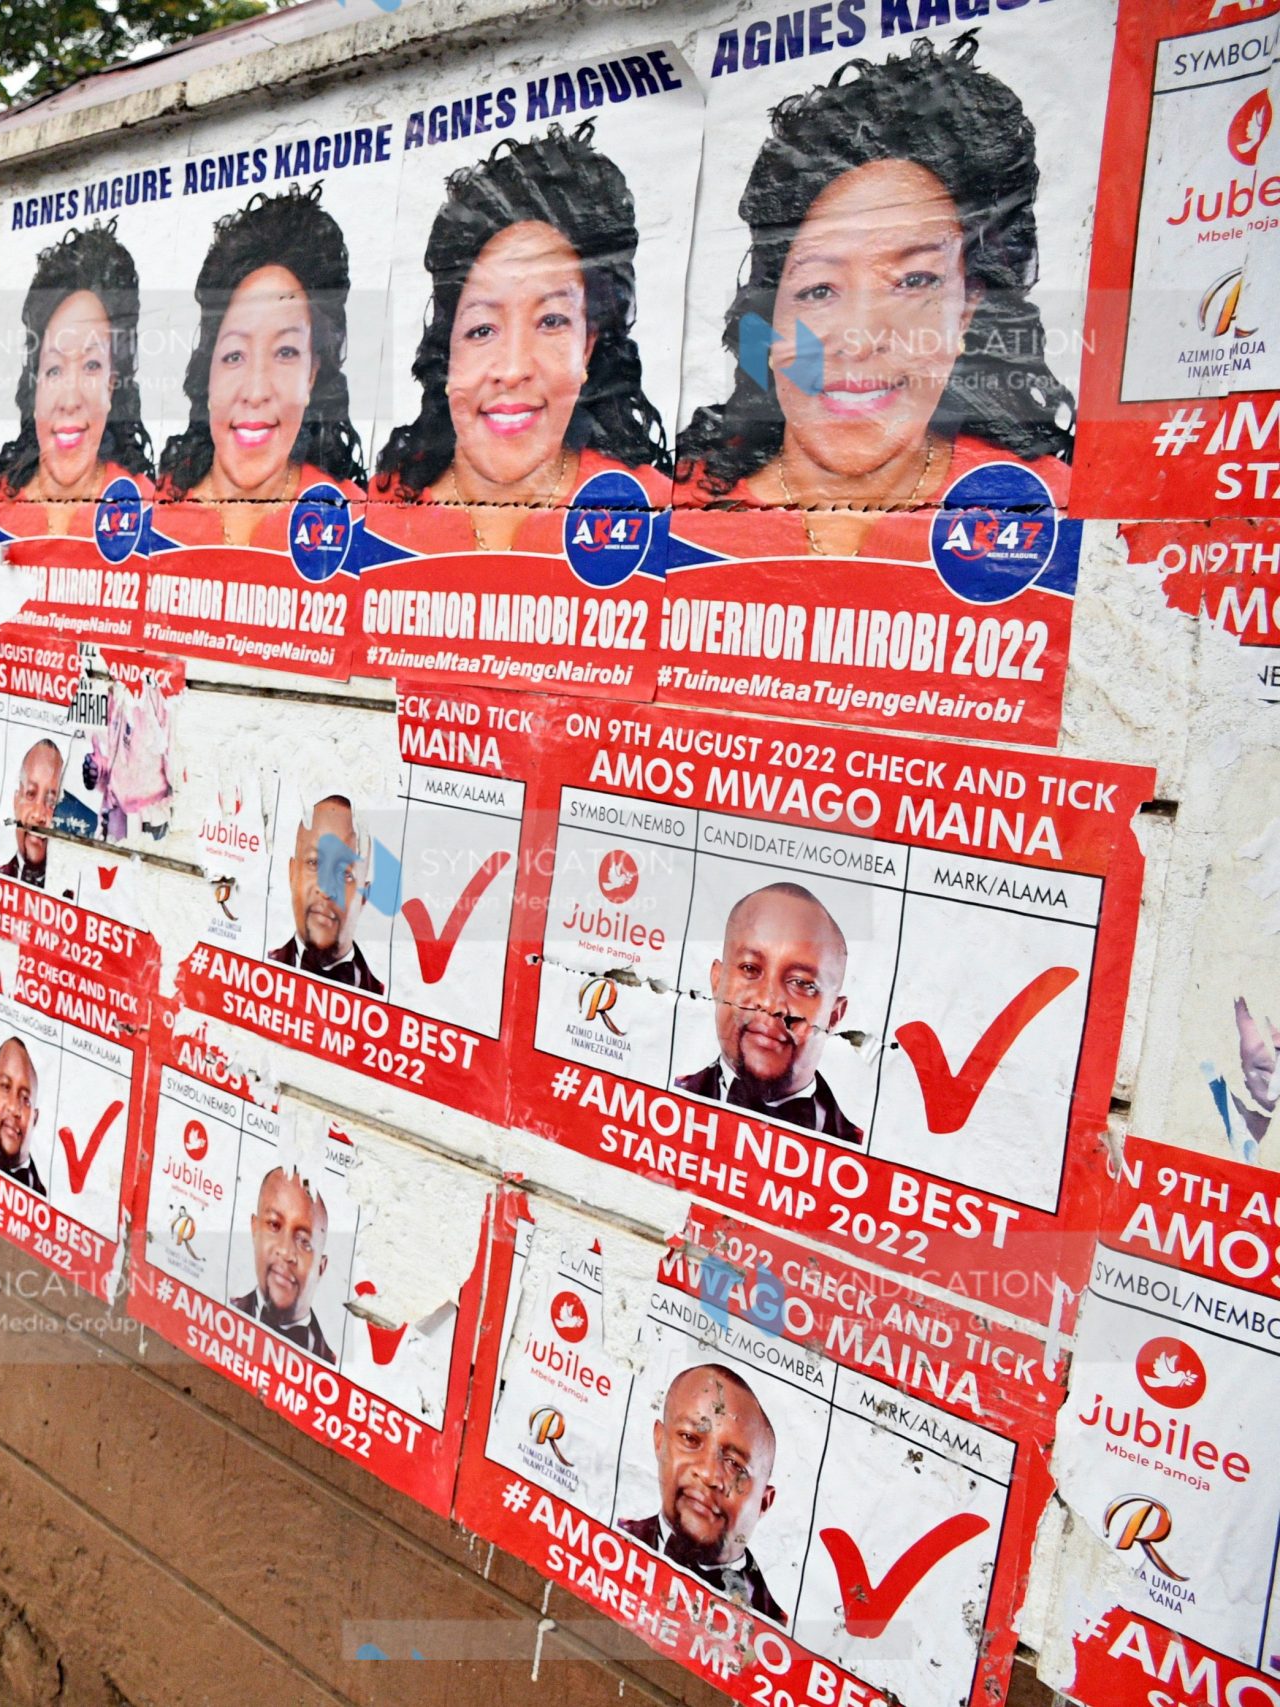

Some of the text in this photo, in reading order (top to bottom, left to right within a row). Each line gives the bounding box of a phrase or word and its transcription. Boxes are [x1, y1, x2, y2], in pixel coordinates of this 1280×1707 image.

[710, 0, 871, 78] AGNES
[404, 50, 682, 150] AGNES KAGURE
[182, 124, 392, 196] AGNES KAGURE
[12, 168, 172, 231] AGNES KAGURE
[1197, 226, 1243, 243] Mbele
[1178, 348, 1224, 364] AZIMIO
[48, 566, 102, 608] NAIROBI
[104, 572, 141, 610] 2022
[224, 581, 348, 637] NAIROBI 2022
[143, 622, 335, 666] #TuinueMtaaTujengeNairobi
[362, 588, 649, 651] GOVERNOR NAIROBI 2022
[810, 606, 1049, 682] NAIROBI 2022
[35, 649, 65, 670] 2022
[109, 662, 140, 682] AND
[366, 646, 634, 686] #TuinueMtaaTujengeNairobi
[436, 699, 533, 734] AND TICK
[657, 664, 1025, 724] #TuinueMtaaTujengeNairobi
[400, 724, 503, 770] MAINA
[566, 713, 1119, 814] ON 9TH AUGUST 2022 CHECK AND TICK
[425, 779, 506, 807] MARK/ALAMA
[588, 749, 1064, 861] AMOS MWAGO MAINA
[570, 801, 686, 838] SYMBOL/NEMBO
[703, 825, 897, 877] CANDIDATE/MGOMBEA
[933, 867, 1068, 908] MARK/ALAMA
[23, 892, 77, 935] NDIO
[85, 916, 137, 958] BEST
[34, 929, 59, 951] MP
[61, 939, 103, 972] 2022
[562, 903, 665, 950] jubilee
[578, 940, 641, 964] Mbele Pamoja
[37, 960, 138, 1015] CHECK AND TICK
[188, 947, 479, 1070] #AMOH NDIO BEST
[55, 992, 121, 1039] MAINA
[222, 991, 426, 1085] STAREHE MP 2022
[566, 1024, 632, 1052] AZIMIO UMOJA
[571, 1037, 624, 1061] INAWEZEKANA
[166, 1076, 238, 1120] SYMBOL/NEMBO
[162, 1153, 224, 1202] jubilee
[550, 1064, 1020, 1251] #AMOH NDIO BEST
[599, 1123, 931, 1265] STAREHE MP 2022
[1157, 1167, 1229, 1213] 9TH
[7, 1219, 31, 1243] MP
[33, 1233, 74, 1271] 2022
[54, 1216, 106, 1265] BEST
[650, 1293, 826, 1389] CANDIDATE/MGOMBEA
[781, 1261, 1039, 1387] CHECK AND TICK
[155, 1275, 424, 1456] #AMOH NDIO BEST
[530, 1366, 589, 1404] Mbele Pamoja
[826, 1315, 984, 1416] MAINA
[186, 1326, 372, 1460] STAREHE MP 2022
[1078, 1394, 1251, 1483] jubilee
[1105, 1442, 1211, 1492] Mbele Pamoja
[501, 1479, 792, 1676] #AMOH NDIO
[546, 1544, 681, 1647] STAREHE
[1151, 1576, 1196, 1605] UMOJA
